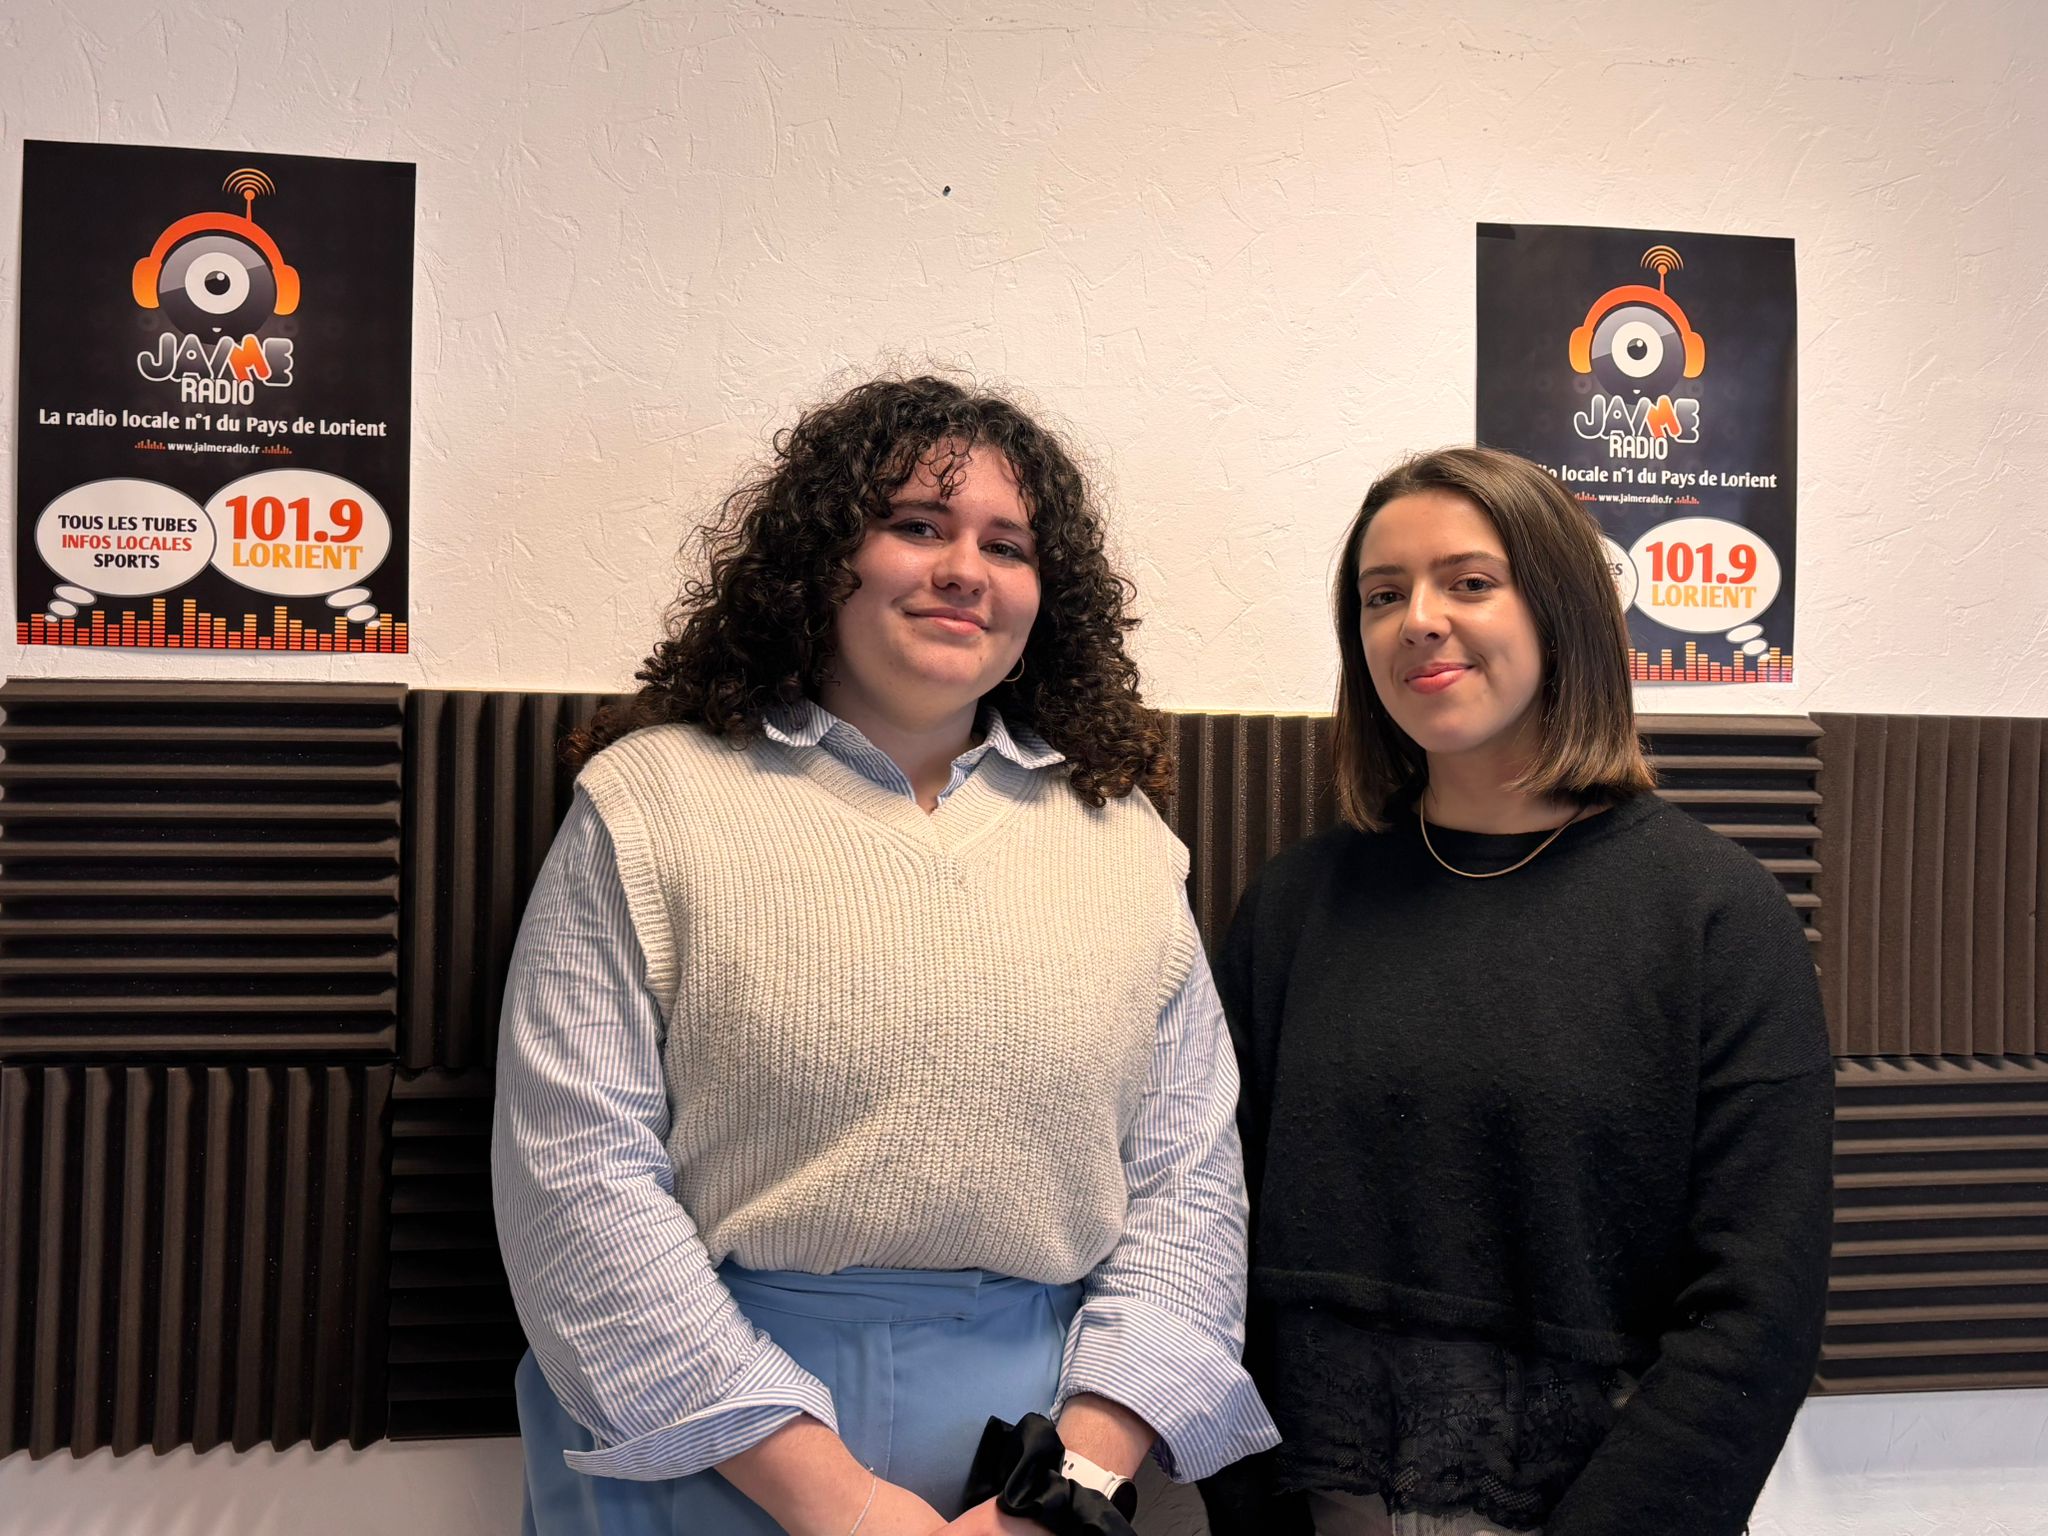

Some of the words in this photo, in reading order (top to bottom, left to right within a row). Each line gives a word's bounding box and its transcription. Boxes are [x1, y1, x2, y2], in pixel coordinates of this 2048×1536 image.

[181, 377, 255, 405] RADIO
[39, 408, 60, 426] La
[66, 408, 117, 428] radio
[122, 410, 180, 430] locale
[216, 414, 240, 432] du
[247, 416, 288, 438] Pays
[292, 416, 315, 435] de
[320, 418, 387, 437] Lorient
[168, 442, 260, 455] www.jaimeradio.fr
[1609, 435, 1668, 460] RADIO
[1562, 464, 1608, 483] locale
[1637, 468, 1656, 484] du
[1661, 470, 1695, 488] Pays
[1699, 470, 1718, 487] de
[1721, 472, 1777, 488] Lorient
[1598, 493, 1673, 505] www.jaimeradio.fr
[58, 514, 103, 531] TOUS
[108, 516, 138, 532] LES
[142, 516, 197, 533] TUBES
[225, 495, 363, 543] 101.9
[61, 533, 111, 550] INFOS
[116, 535, 193, 552] LOCALES
[93, 553, 160, 569] SPORTS
[232, 542, 363, 571] LORIENT
[1645, 541, 1757, 584] 101.9
[1651, 583, 1757, 609] LORIENT
